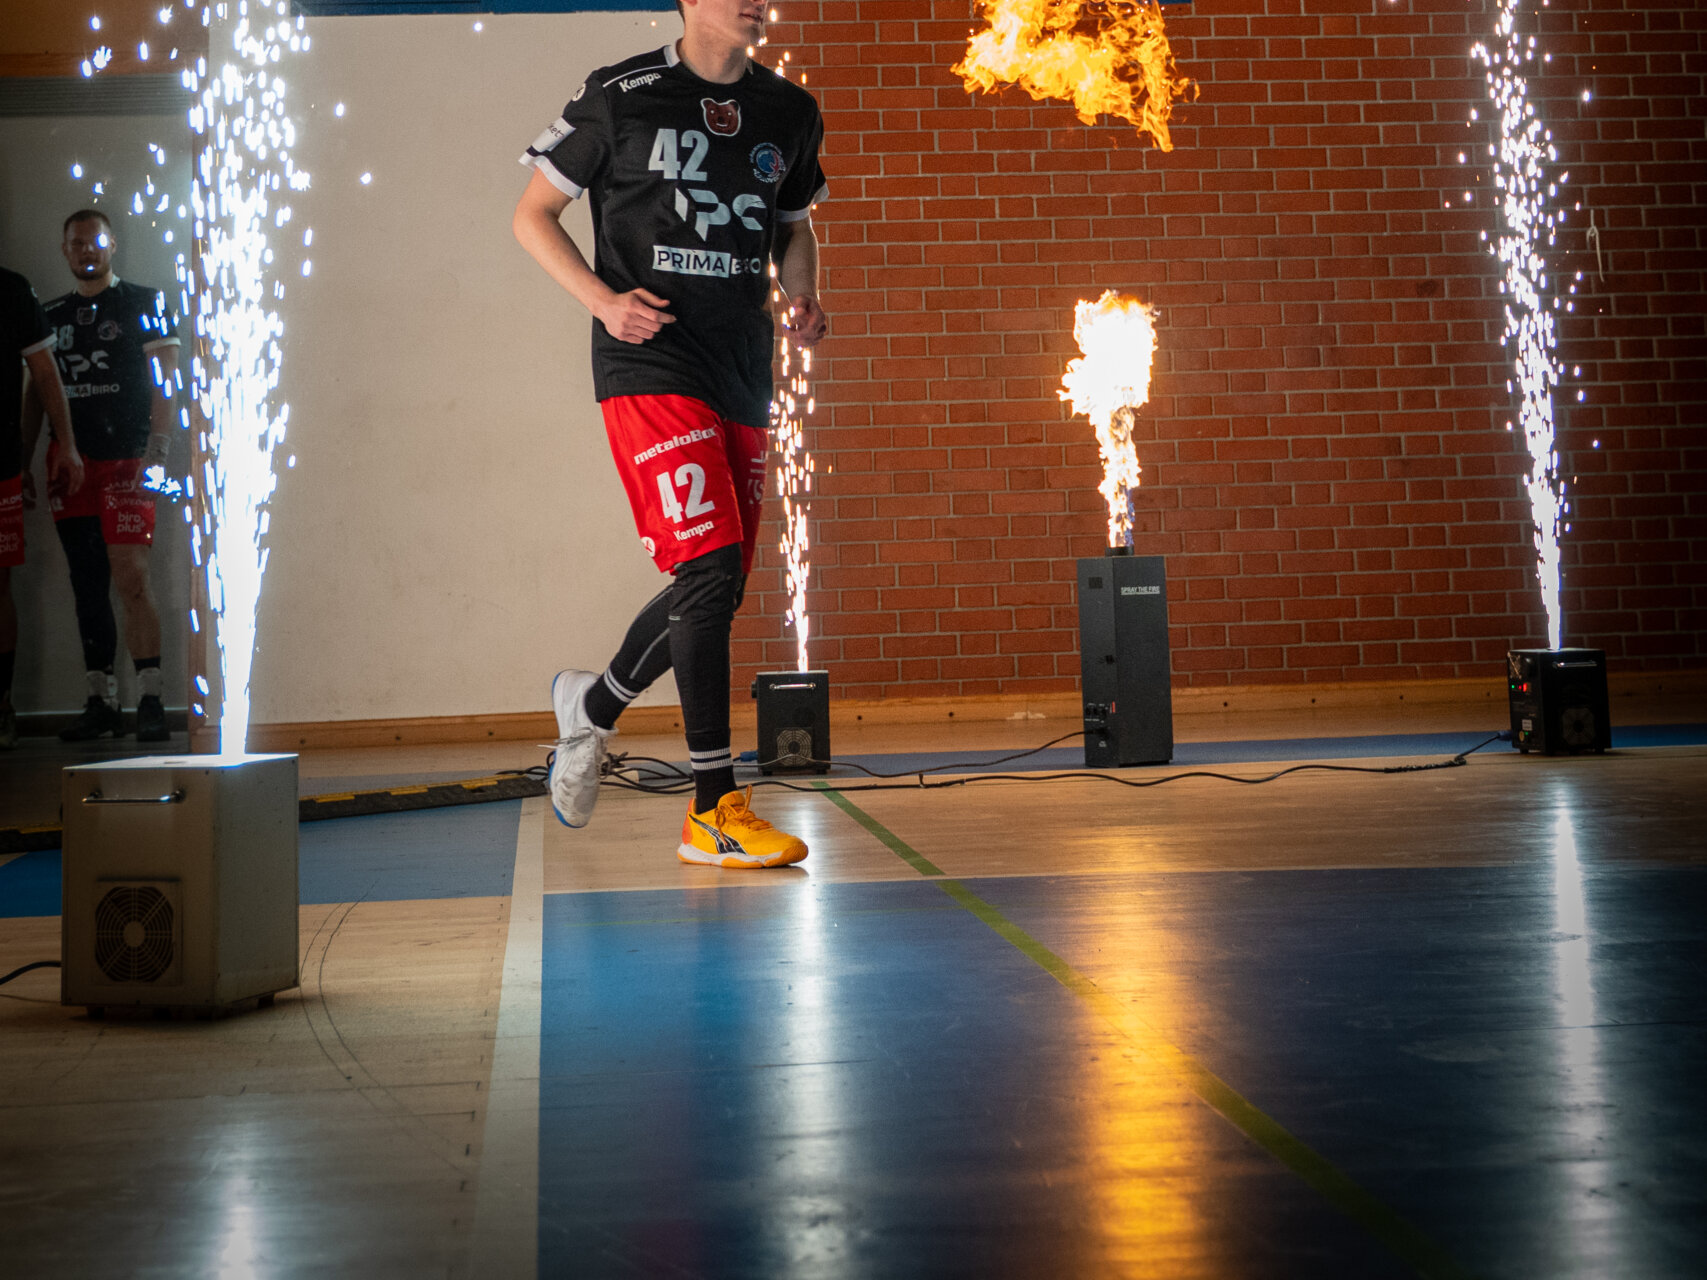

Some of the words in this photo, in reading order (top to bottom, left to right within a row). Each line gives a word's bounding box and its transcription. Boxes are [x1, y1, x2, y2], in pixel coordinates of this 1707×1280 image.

[618, 72, 662, 93] Kempa
[648, 128, 709, 182] 42
[657, 250, 726, 273] PRIMA
[92, 383, 120, 395] BIRO
[656, 463, 716, 524] 42
[673, 520, 715, 541] Kempa
